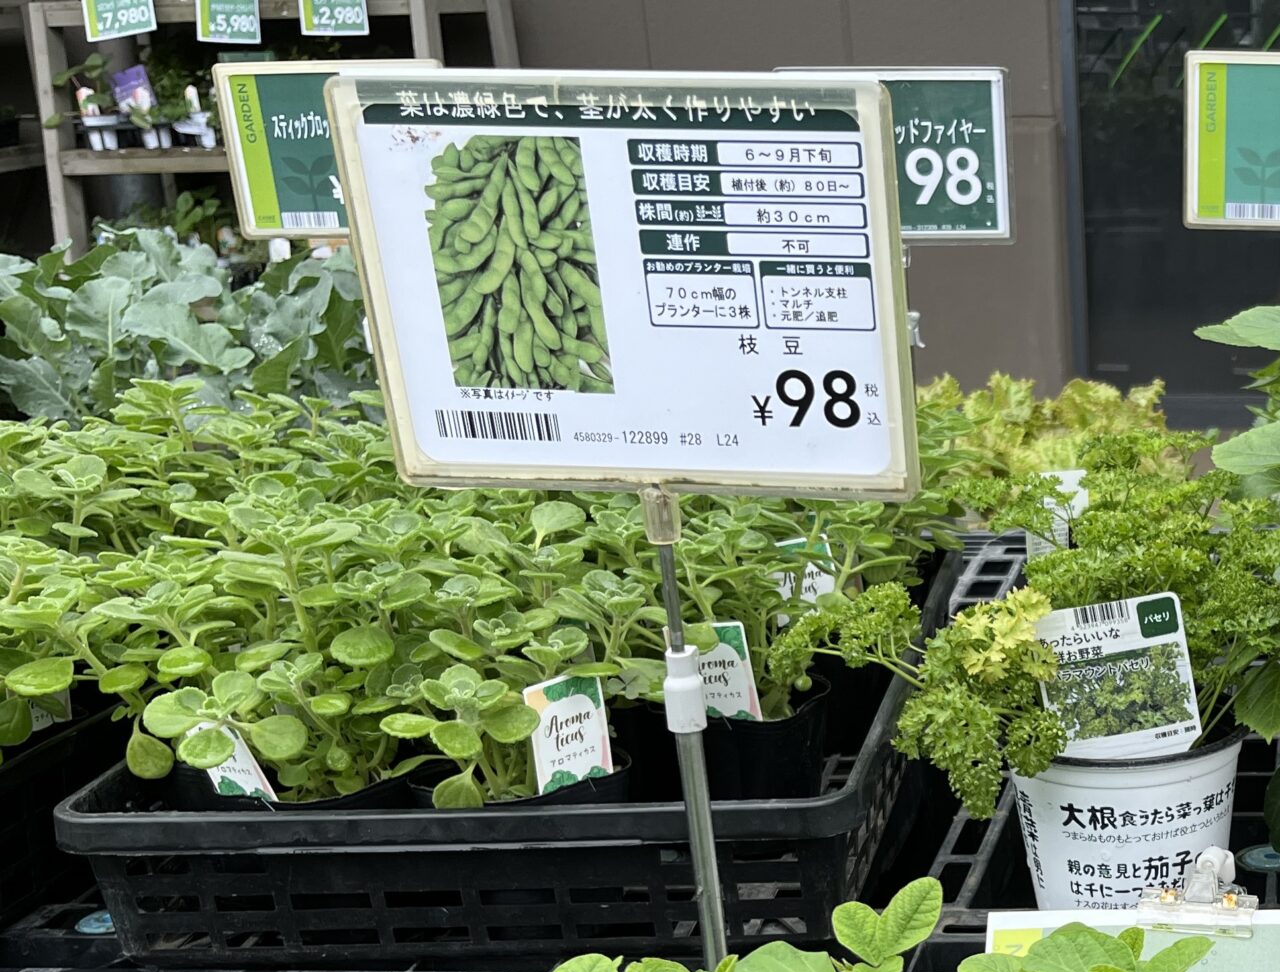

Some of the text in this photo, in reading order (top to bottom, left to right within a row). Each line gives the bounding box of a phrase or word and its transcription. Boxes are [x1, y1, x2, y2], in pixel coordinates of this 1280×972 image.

[1206, 71, 1217, 133] GARDEN
[237, 83, 257, 144] GARDEN
[638, 143, 708, 163] 収穫時期
[642, 173, 711, 192] 収穫目安
[905, 147, 983, 206] 98
[666, 233, 810, 254] 連作 不可
[776, 264, 855, 276] 一緒に買うと便利
[573, 431, 740, 446] 4580329-122899 #28 L24
[1144, 611, 1170, 624] パセリ
[544, 711, 592, 738] Aroma
[1067, 850, 1203, 881] 親の意見と茄子
